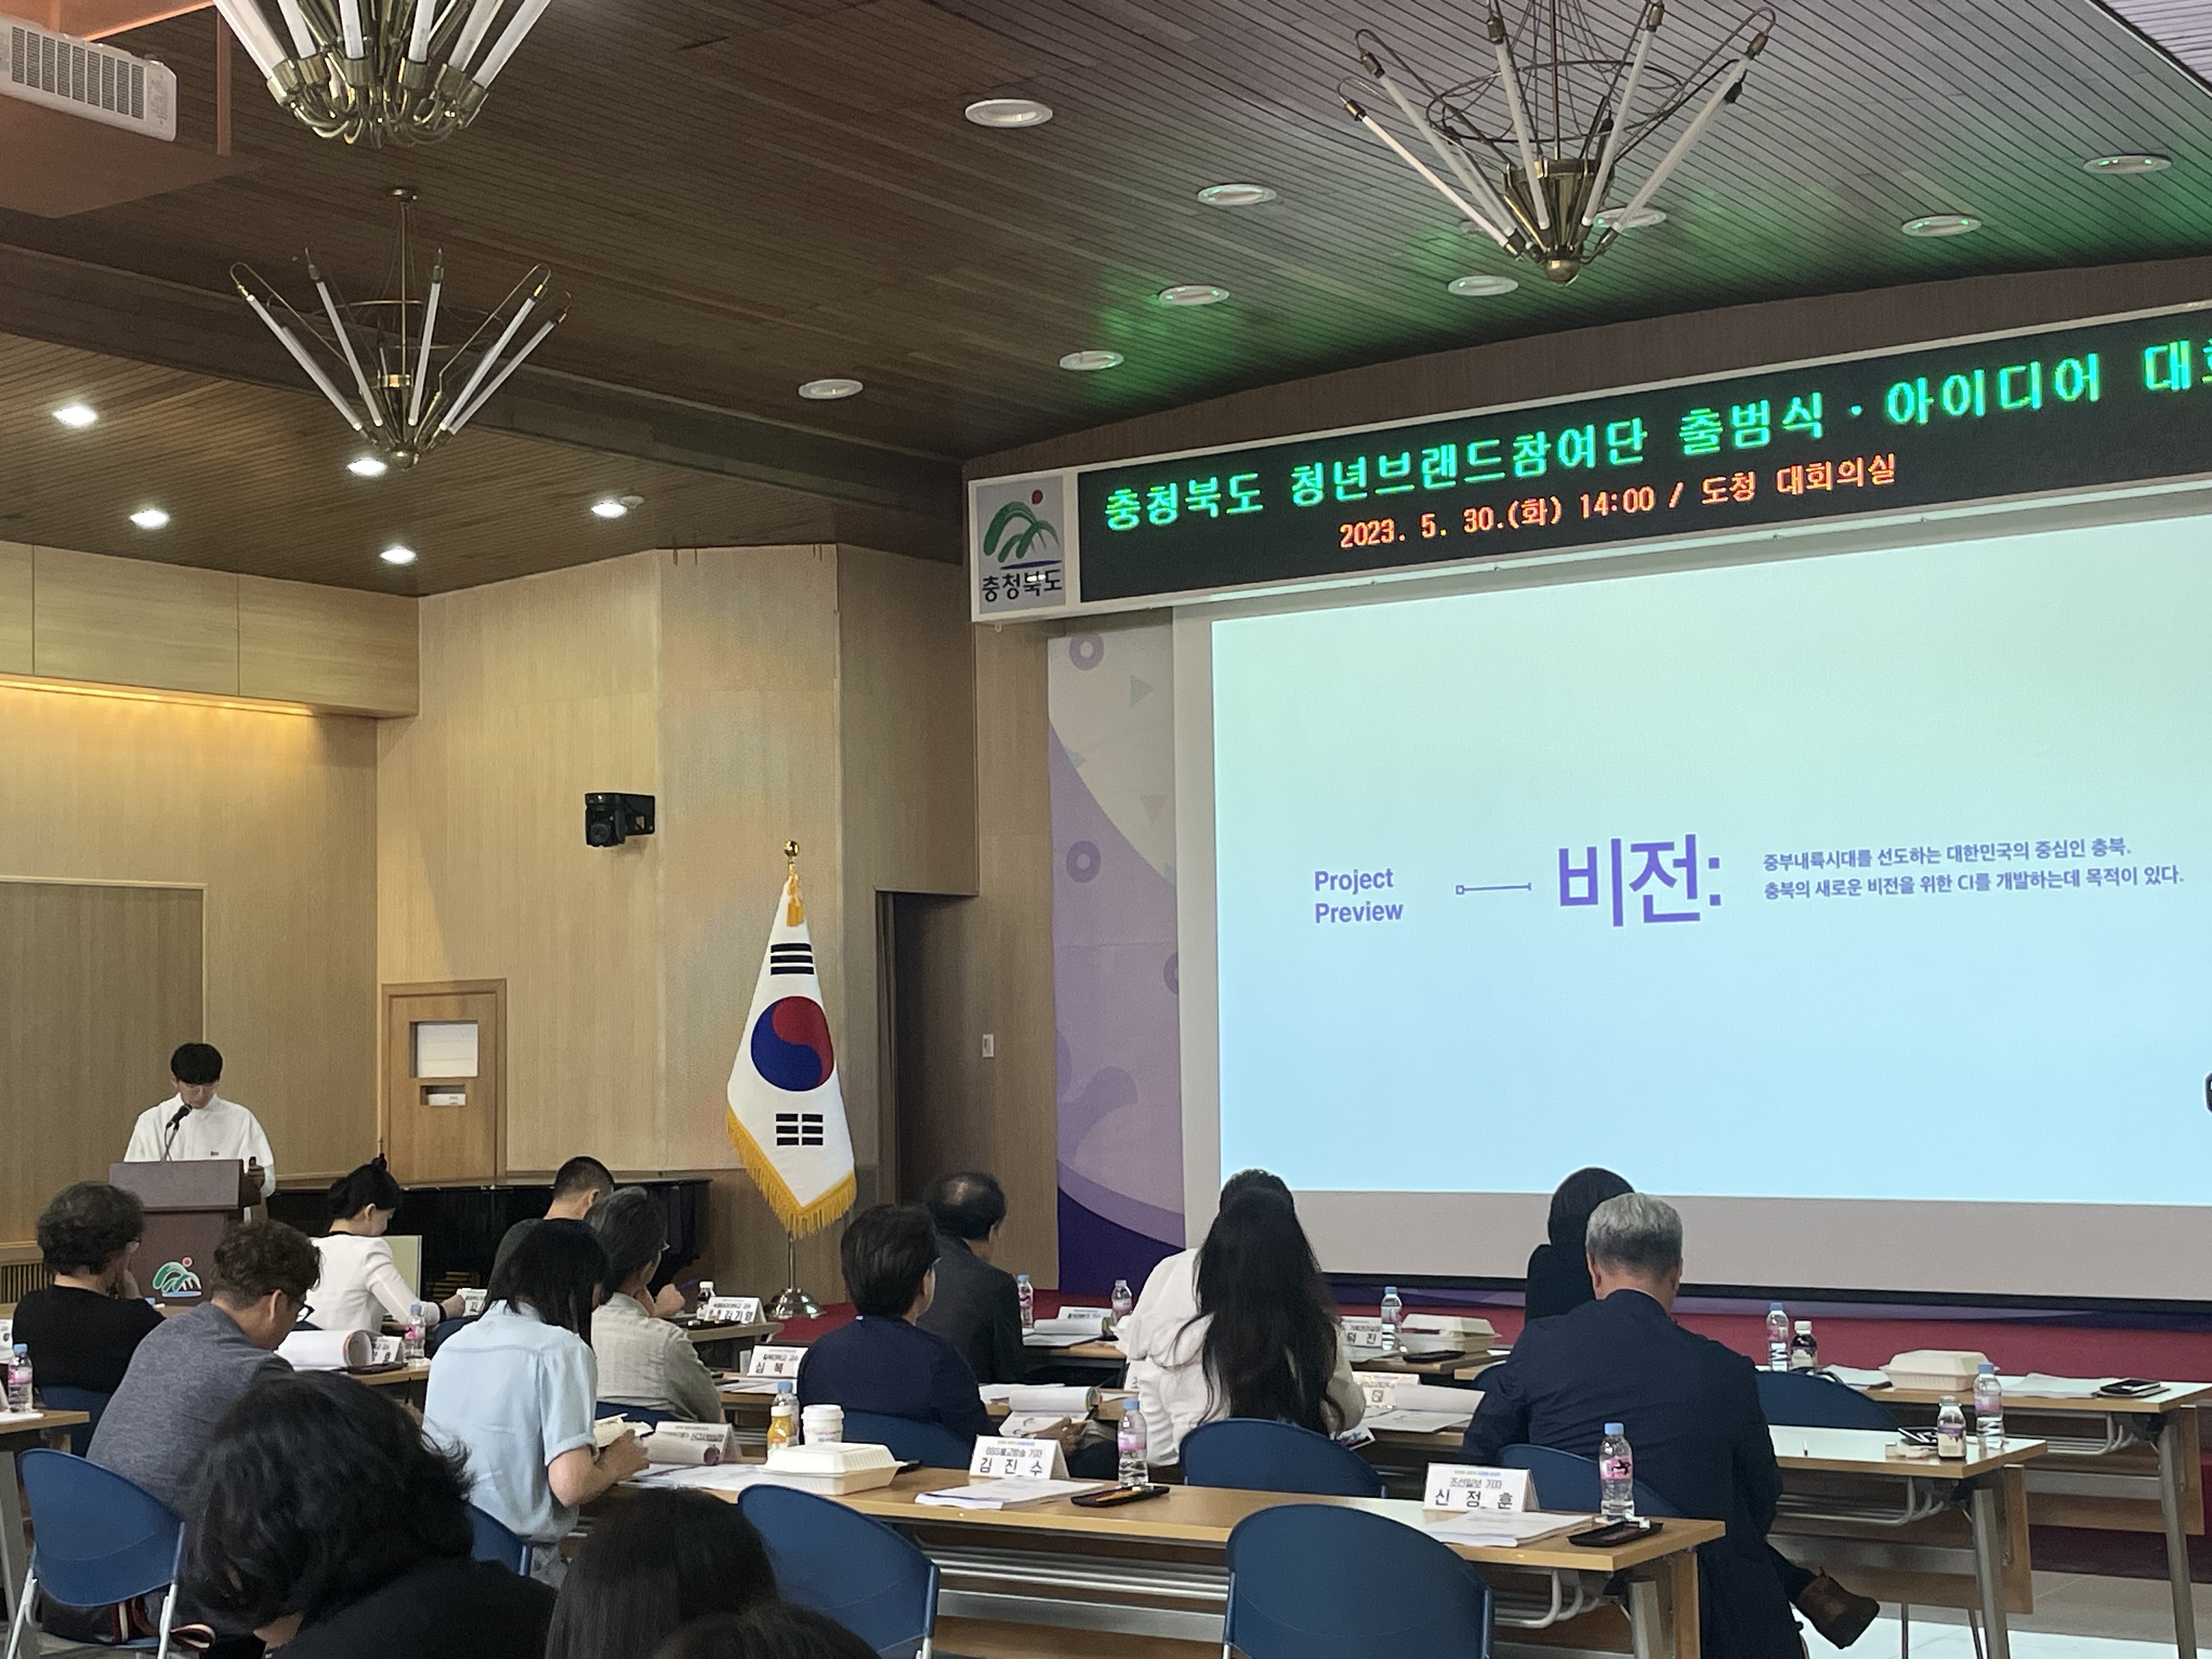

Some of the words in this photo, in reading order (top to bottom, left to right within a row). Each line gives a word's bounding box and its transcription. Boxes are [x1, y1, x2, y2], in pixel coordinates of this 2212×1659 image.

[1105, 473, 1263, 530] 충청북도
[1291, 417, 1647, 506] 청년브랜드참여단
[2142, 338, 2212, 392] 대
[1340, 517, 1404, 548] 2023.
[1421, 514, 1446, 538] 5.
[1580, 486, 1655, 518] 14:00
[1702, 471, 1755, 504] 도청
[1777, 453, 1894, 494] 대회의실
[983, 568, 1063, 602] 충청북도
[1763, 850, 1872, 871] 중부내륙시대를
[1878, 846, 1942, 866] 선도하는
[1946, 841, 2029, 862] 대한민국의
[2035, 839, 2085, 859] 중심인
[2091, 837, 2131, 857] 충북.
[1315, 868, 1393, 895] Project
[1559, 834, 1721, 927] 비전:
[1764, 880, 1810, 900] 충북의
[1815, 878, 1863, 898] 새로운
[1867, 876, 1915, 895] 비전을
[1920, 874, 1952, 893] 위한
[1957, 872, 1991, 891] CI를
[1996, 869, 2080, 890] 개발하는데
[2086, 866, 2137, 887] 목적이
[2144, 865, 2184, 885] 있다.
[1316, 901, 1403, 923] Preview
